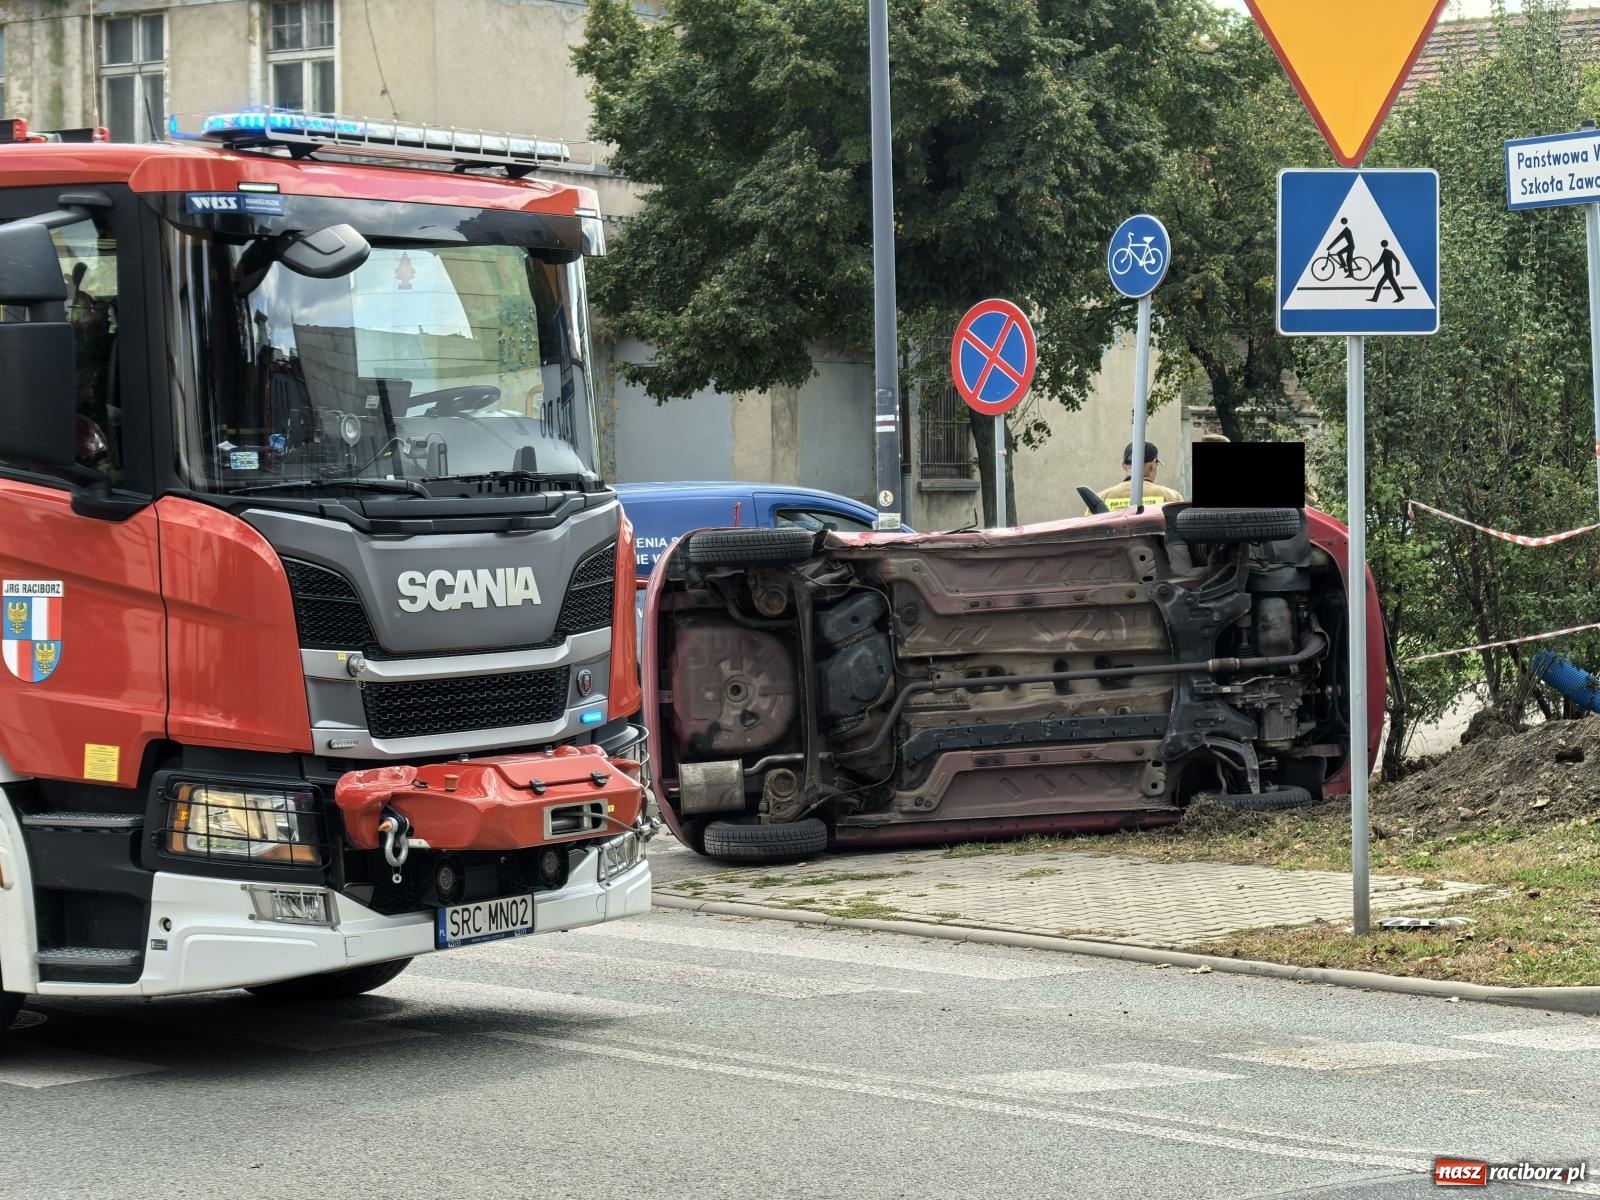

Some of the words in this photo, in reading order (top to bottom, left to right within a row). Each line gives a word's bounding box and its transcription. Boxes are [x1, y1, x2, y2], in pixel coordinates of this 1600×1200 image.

[1517, 150, 1588, 170] Państwowa
[1521, 175, 1563, 195] Szkoła
[636, 537, 668, 548] ENIA
[5, 583, 20, 593] JRG
[397, 566, 542, 613] SCANIA
[450, 905, 482, 937] SRC
